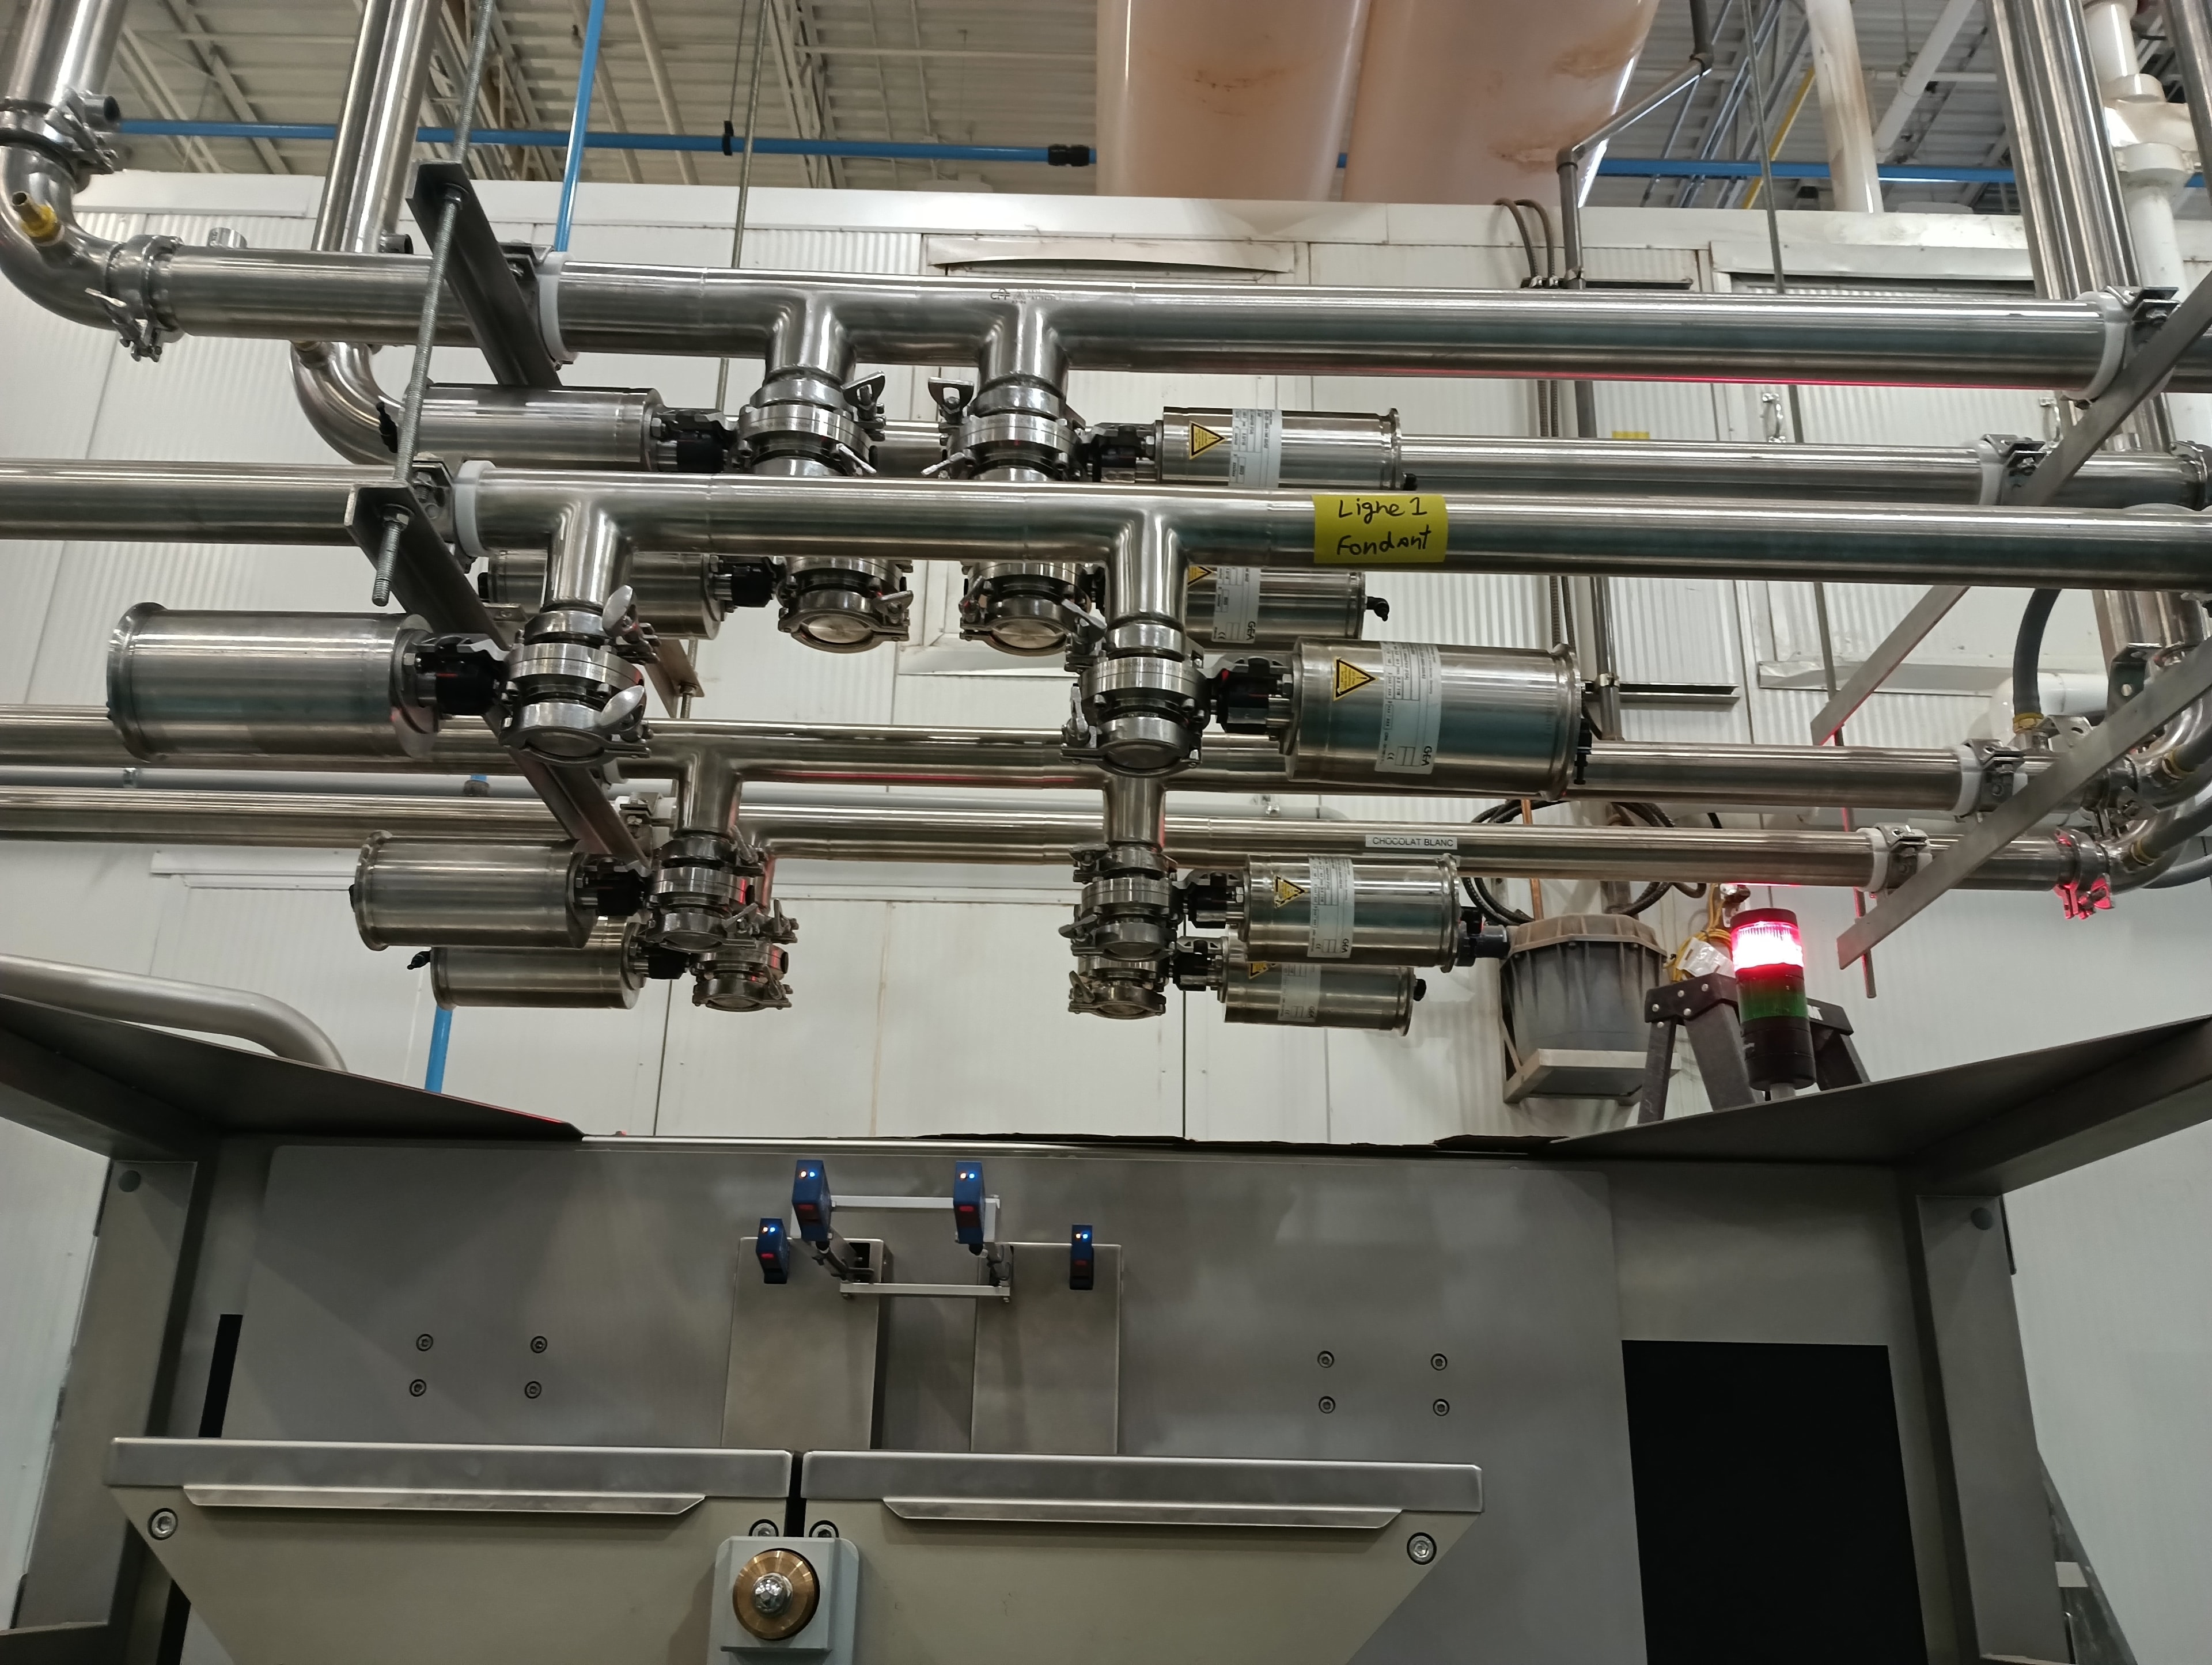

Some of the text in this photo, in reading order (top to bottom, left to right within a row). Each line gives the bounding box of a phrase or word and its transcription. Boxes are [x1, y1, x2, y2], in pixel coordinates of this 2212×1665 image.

[1339, 496, 1427, 524] Ligne 1
[1246, 621, 1256, 640] GEA
[1421, 746, 1433, 766] GEA
[1372, 837, 1454, 847] CHOCOLAT BLANC
